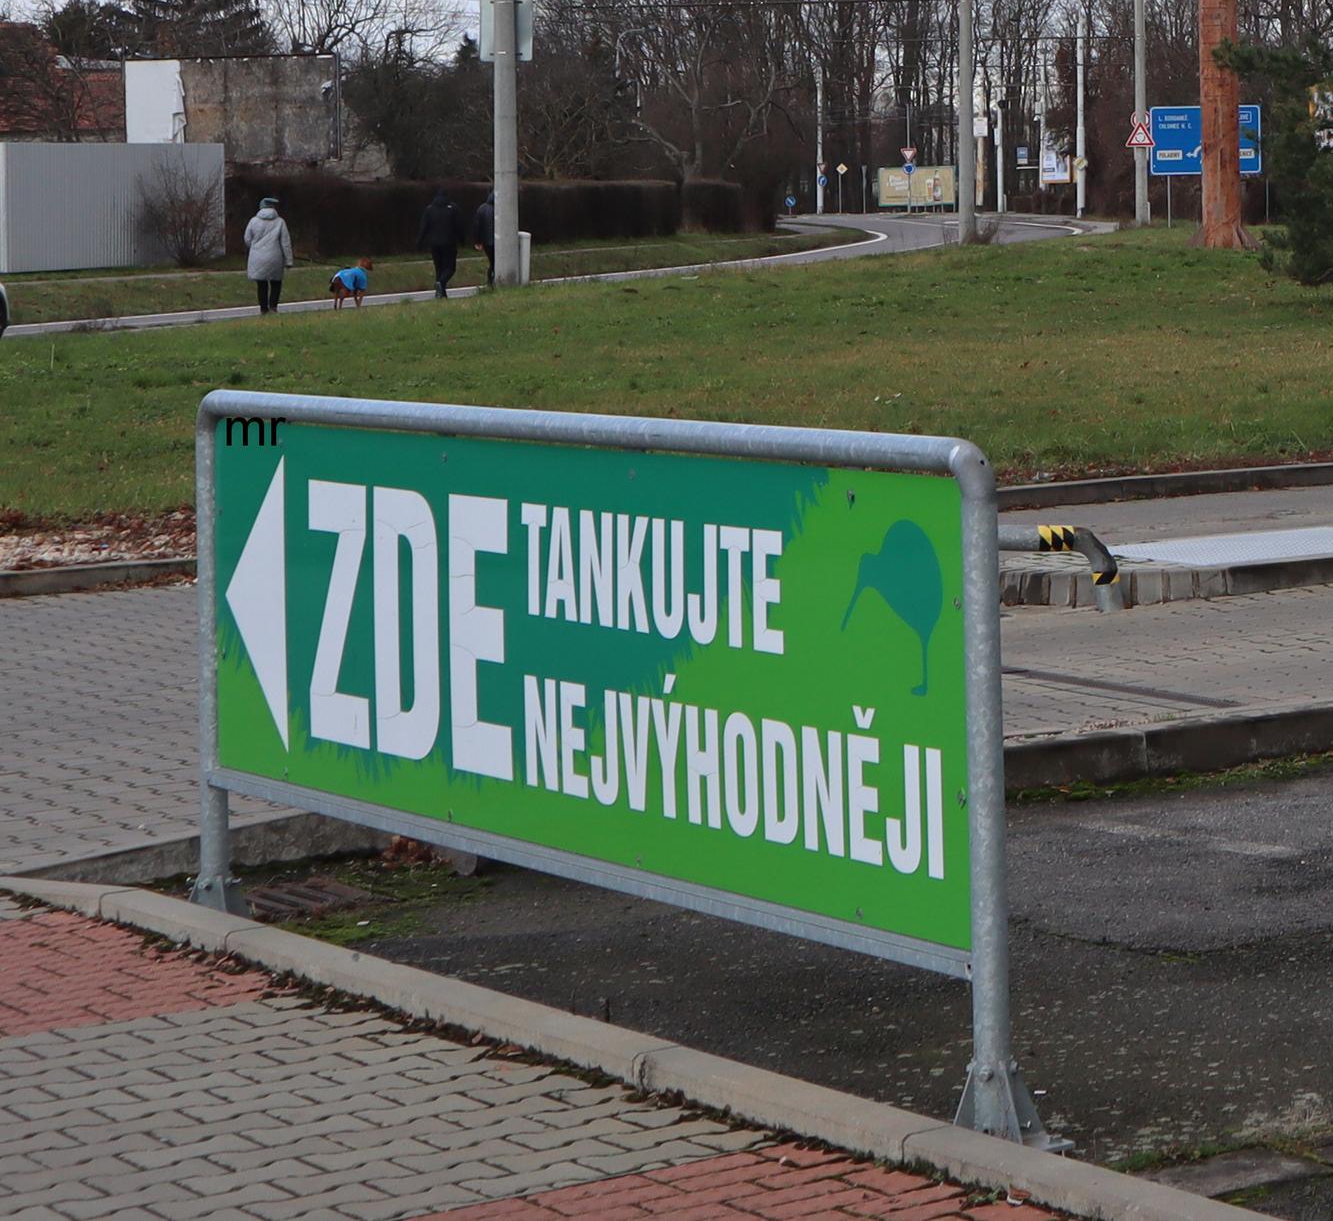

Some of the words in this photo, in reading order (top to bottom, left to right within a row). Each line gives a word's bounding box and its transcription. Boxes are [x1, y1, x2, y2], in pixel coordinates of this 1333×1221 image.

[307, 478, 514, 782] ZDE
[520, 502, 784, 656] TANKUJTE
[523, 674, 945, 881] NEJVÝHODNĚJI
